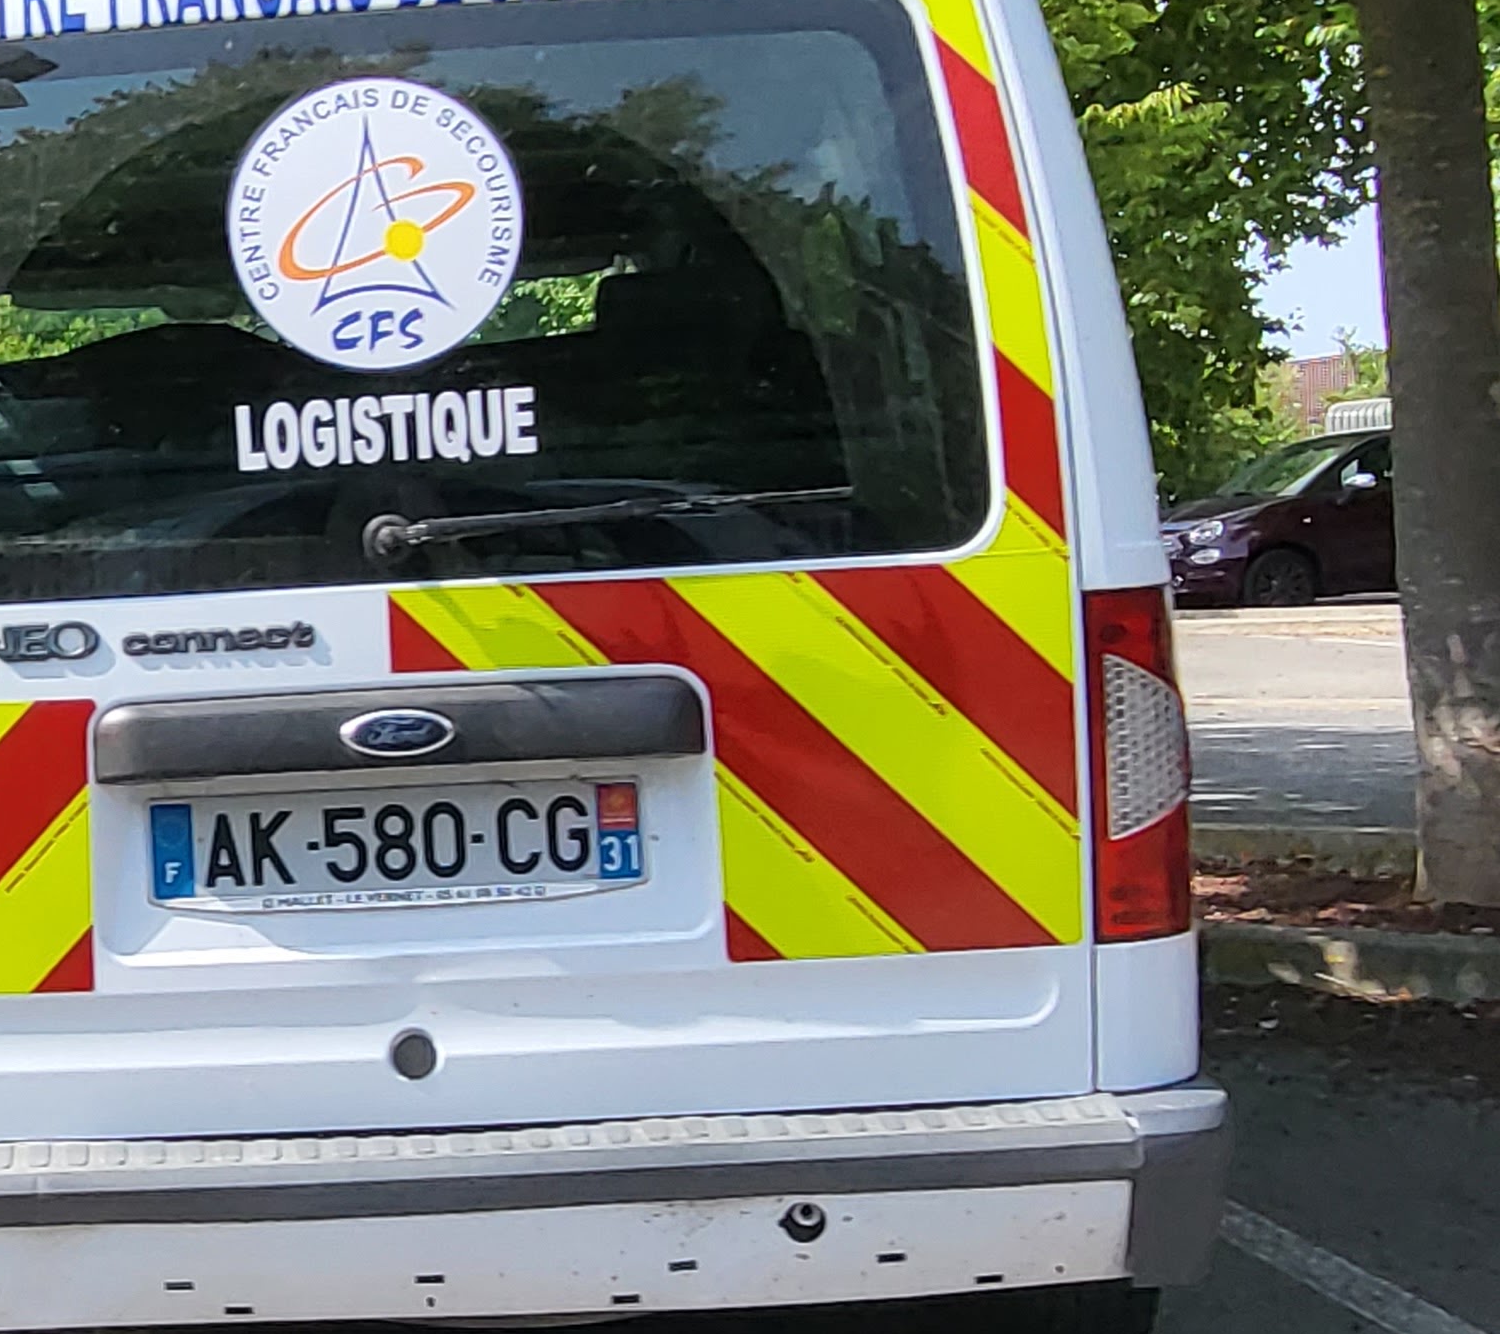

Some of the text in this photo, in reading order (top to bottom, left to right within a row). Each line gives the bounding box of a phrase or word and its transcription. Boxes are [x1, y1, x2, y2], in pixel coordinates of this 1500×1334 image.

[240, 87, 514, 301] CENTRE FRANCAIS DE SECOURISME
[331, 307, 425, 352] CFS
[234, 386, 538, 472] LOGISTIQUE
[122, 620, 316, 657] connect
[204, 794, 591, 888] AK-580-CG
[600, 834, 641, 872] 31
[163, 861, 182, 884] F
